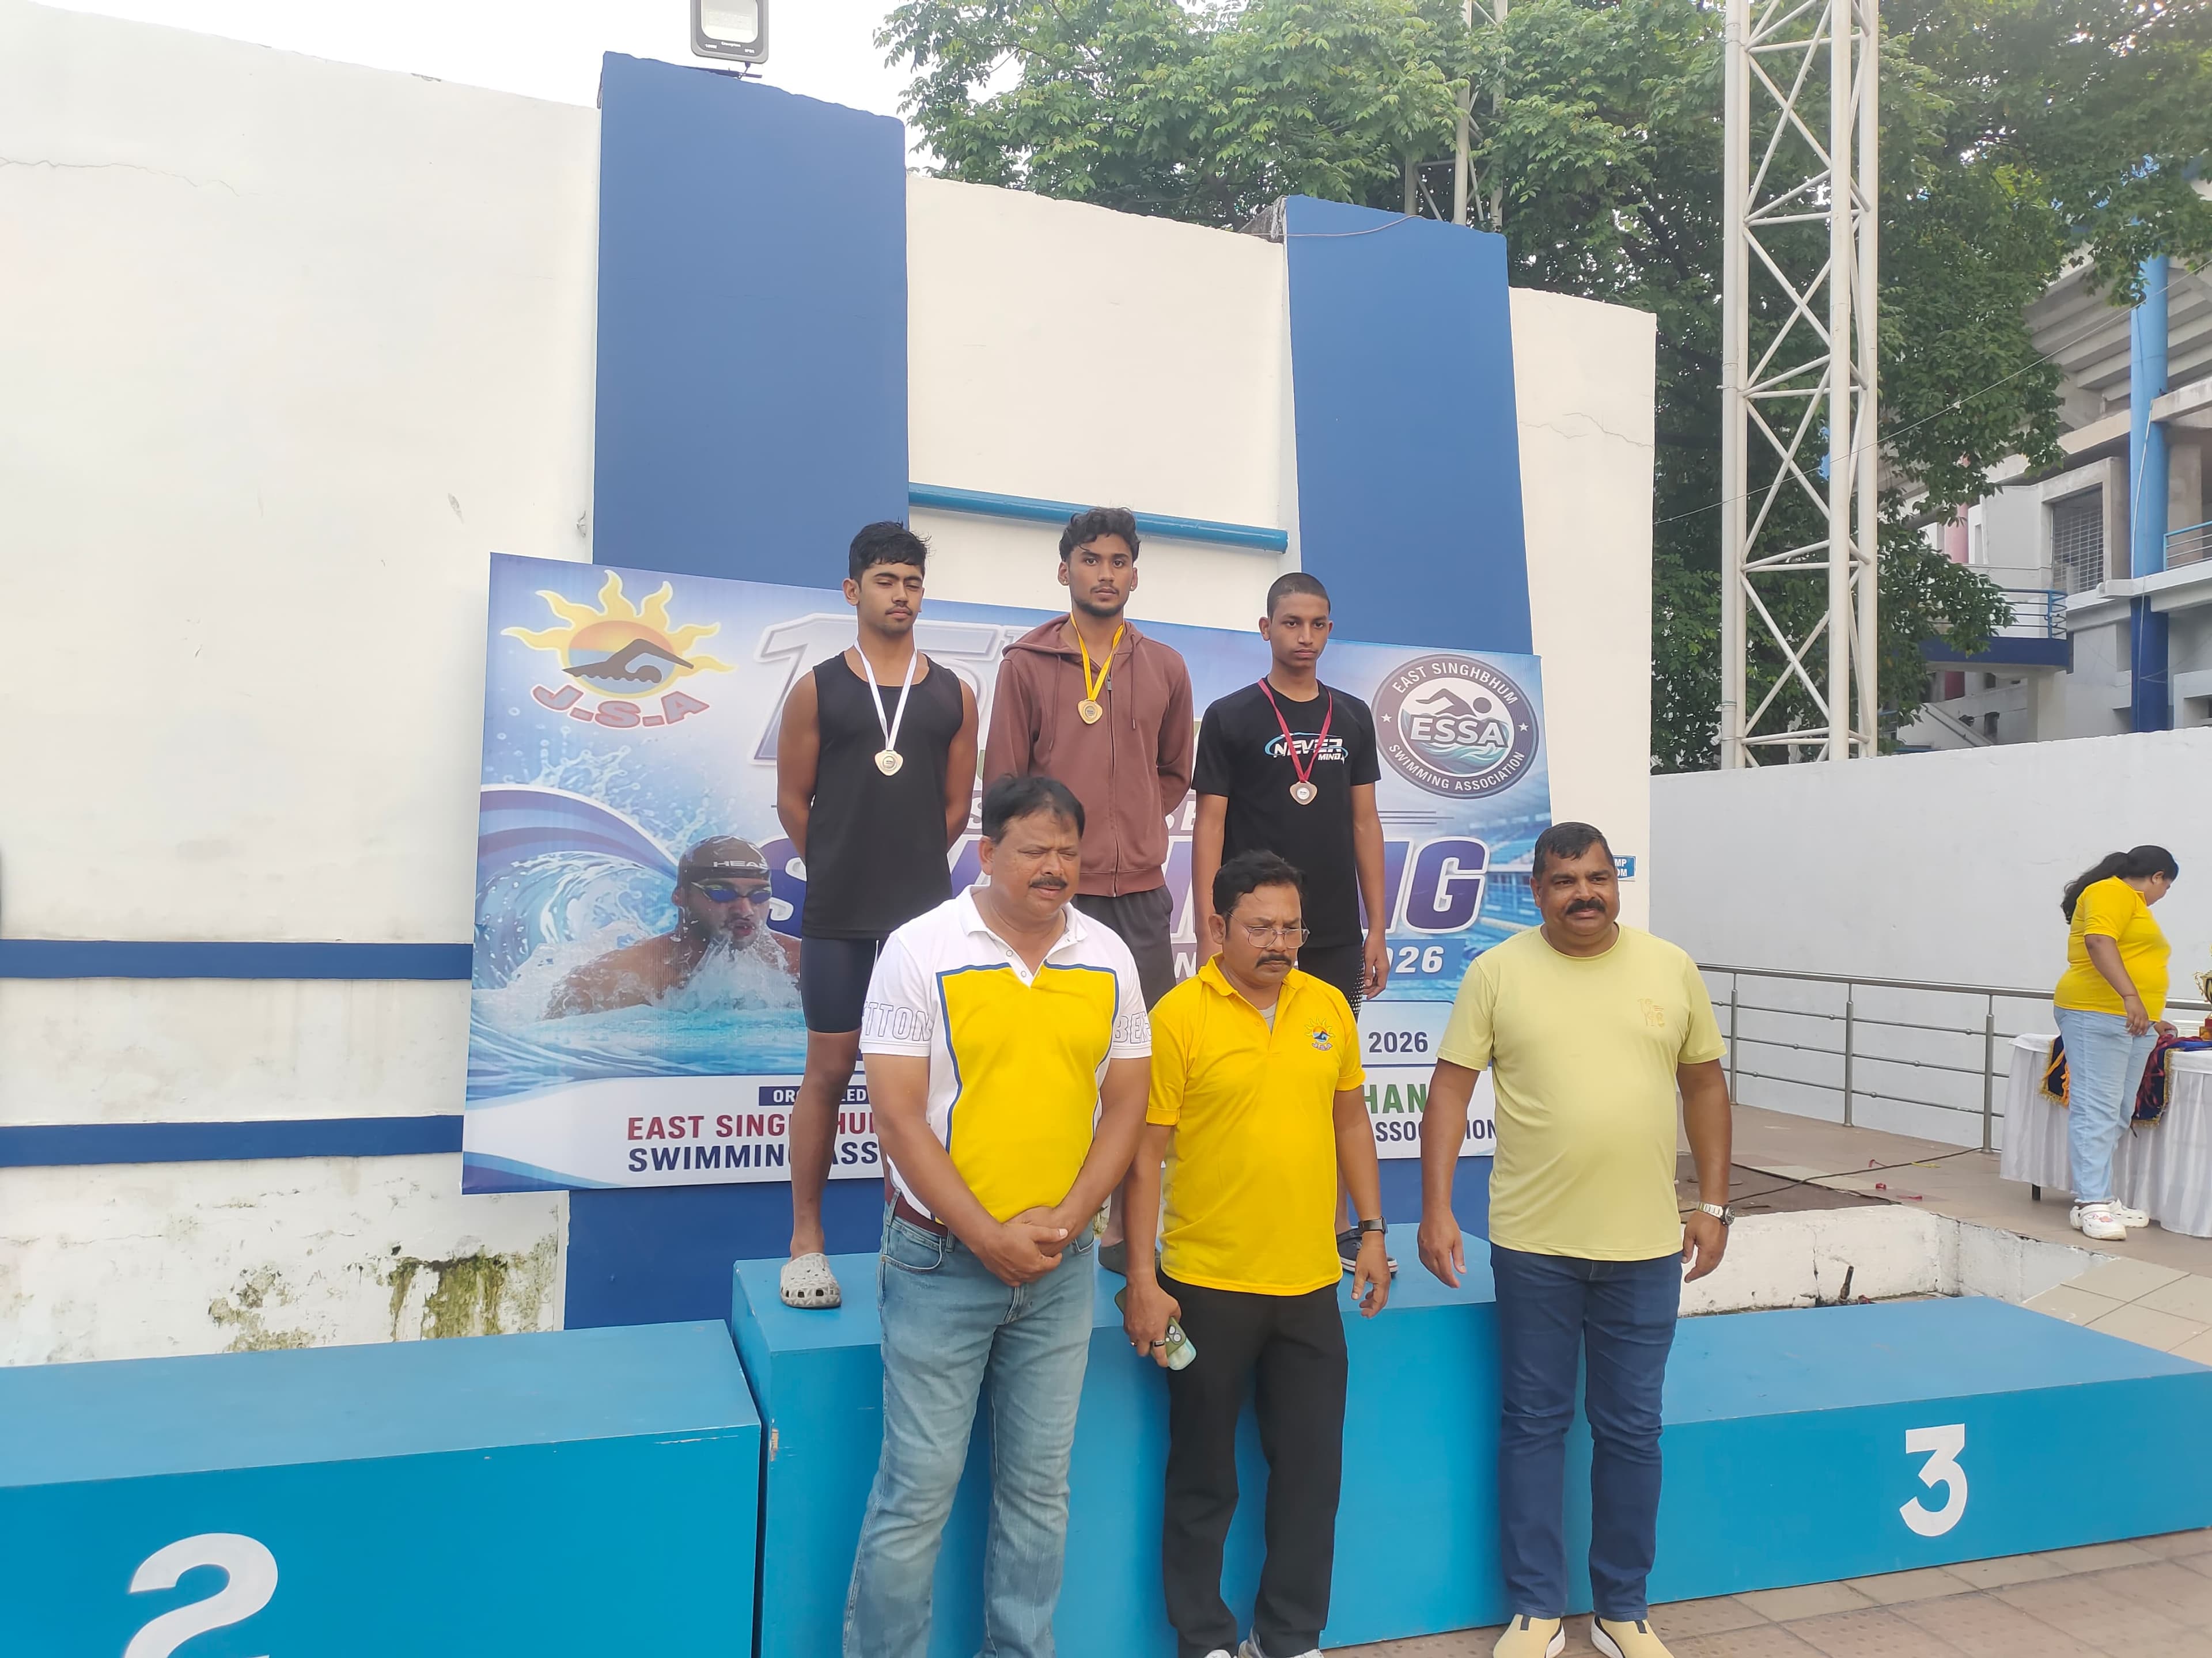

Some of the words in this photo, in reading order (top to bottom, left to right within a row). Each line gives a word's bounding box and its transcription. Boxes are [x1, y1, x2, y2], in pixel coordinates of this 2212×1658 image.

[1392, 666, 1427, 694] EAST
[1431, 662, 1518, 705] SINGHBHUM
[1410, 716, 1506, 746] ESSA
[1317, 753, 1342, 761] MIND
[1389, 744, 1449, 790] SWIMMING
[1455, 752, 1525, 791] ASSOCIATION
[1368, 1031, 1429, 1053] 2026
[627, 1116, 704, 1140] EAST
[628, 1143, 791, 1173] SWIMMIN
[1899, 1423, 1968, 1536] 3
[124, 1532, 278, 1658] 2
